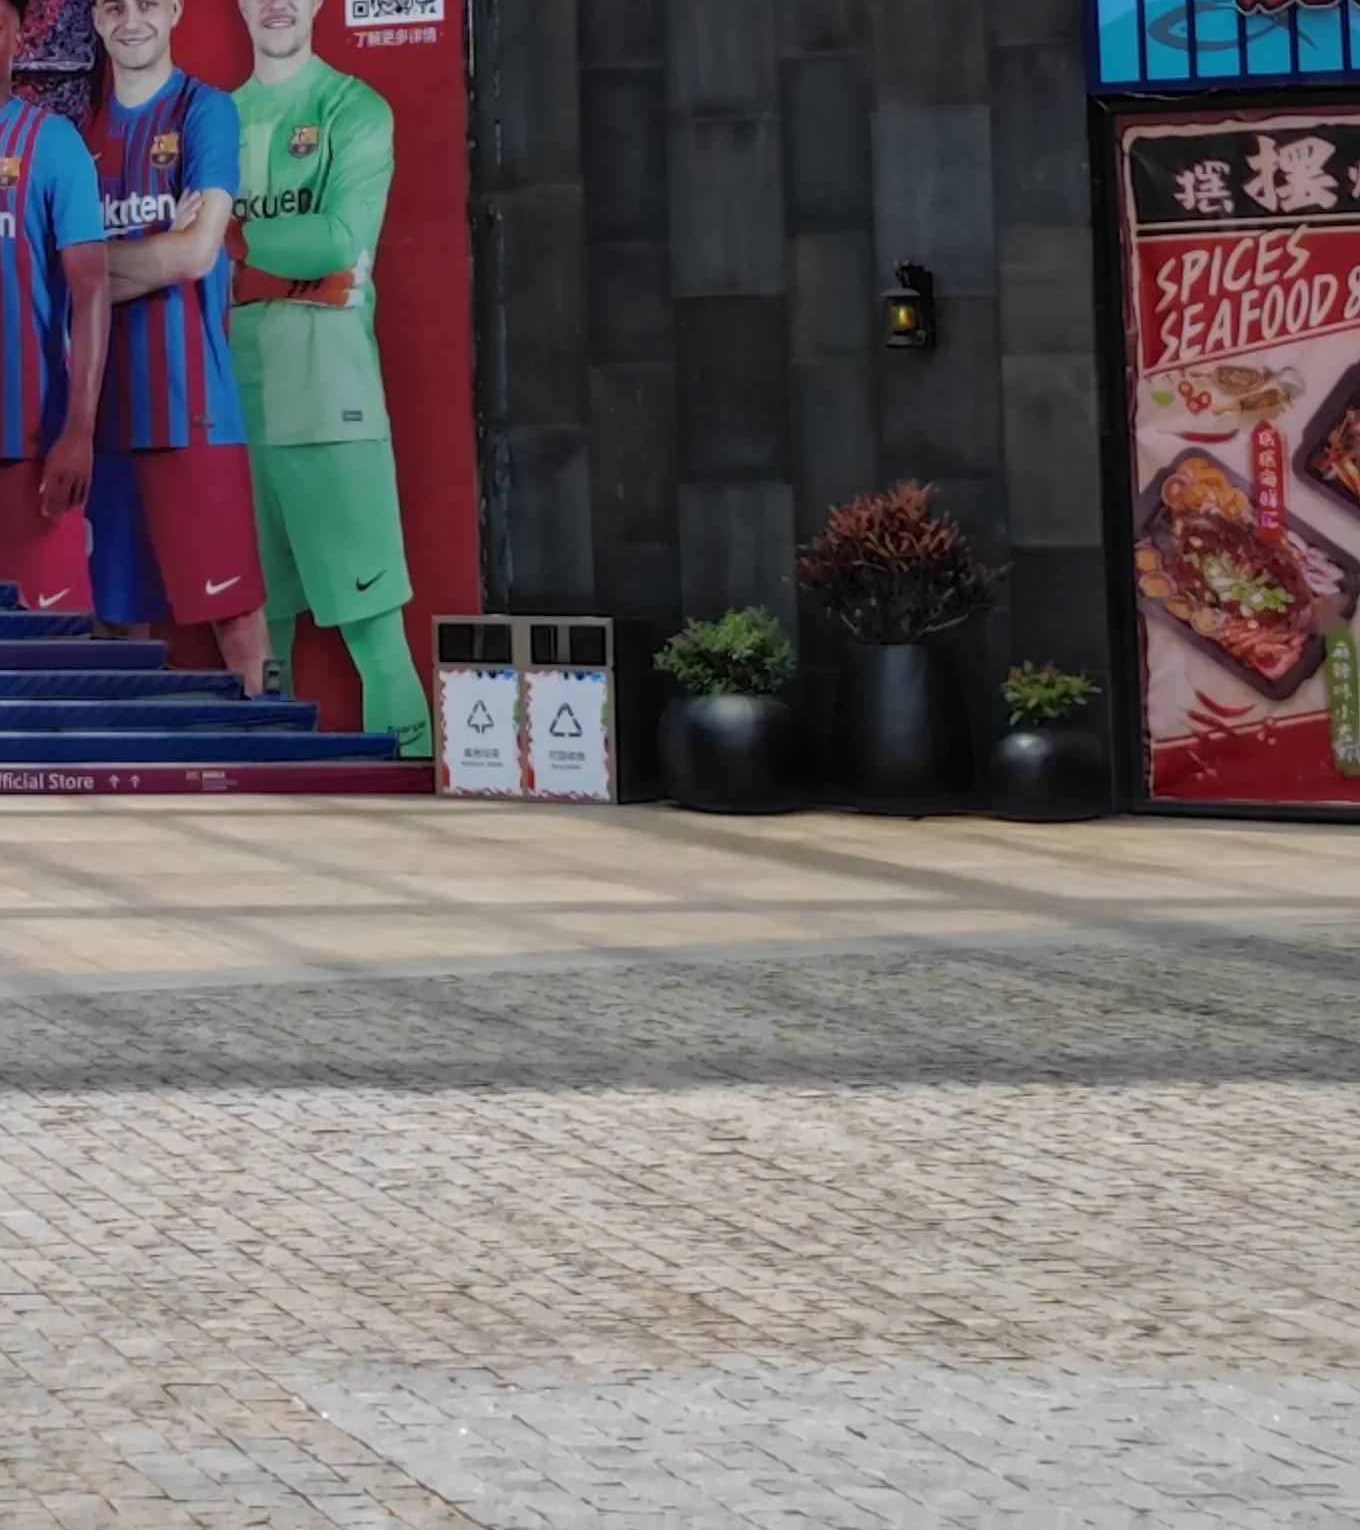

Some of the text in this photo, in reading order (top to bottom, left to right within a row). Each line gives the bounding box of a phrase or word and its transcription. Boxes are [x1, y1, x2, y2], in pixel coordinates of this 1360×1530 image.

[1155, 223, 1311, 314] SPICES
[1154, 273, 1338, 367] SEAFOOD
[48, 772, 95, 790] Store
